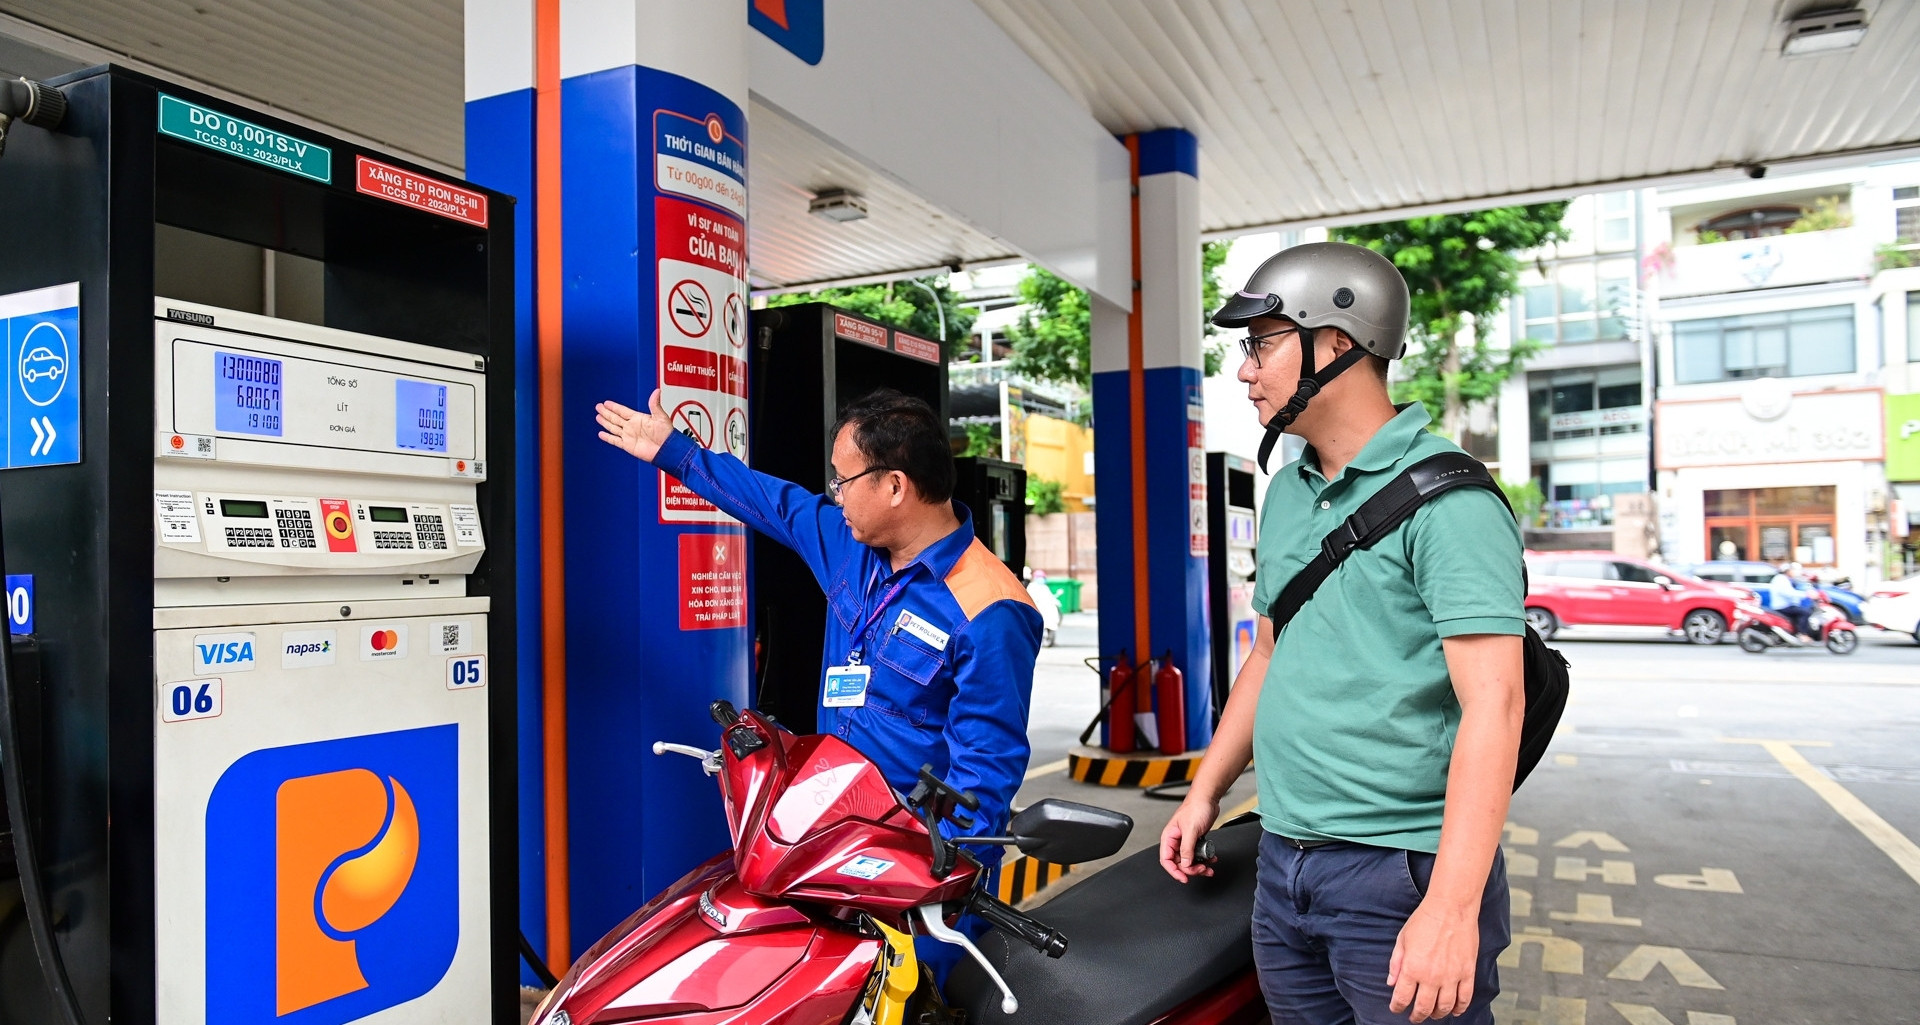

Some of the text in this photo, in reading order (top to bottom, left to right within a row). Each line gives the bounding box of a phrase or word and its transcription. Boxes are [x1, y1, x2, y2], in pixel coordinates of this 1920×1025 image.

[190, 108, 307, 157] DO 0,001S-V
[194, 130, 227, 147] TCCS
[230, 141, 243, 152] 03
[253, 149, 302, 171] 2023/PLX
[664, 134, 692, 154] THỜI
[694, 143, 715, 162] GIAN
[717, 152, 731, 170] BÁN
[368, 166, 478, 209] XĂNG E10 RON 95-III
[667, 166, 683, 181] Từ
[685, 171, 713, 190] 00g00
[716, 182, 729, 197] đến
[381, 184, 407, 199] TCCS
[409, 193, 420, 203] 07
[428, 199, 467, 217] 2023/PLX
[688, 213, 739, 242] VÌ SỰ AN TOÀN
[689, 234, 739, 271] CỦA BẠN
[169, 309, 213, 324] TATSUNO
[223, 355, 279, 385] 1300080
[667, 361, 716, 377] CẤM HÚT THUỐC
[327, 376, 358, 388] TỔNG SỐ
[337, 403, 348, 412] LÍT
[438, 387, 444, 407] 0
[249, 413, 279, 430] 19100
[420, 432, 444, 446] 19830
[666, 495, 681, 506] ĐIỆN
[682, 497, 698, 507] THOẠI
[692, 571, 718, 580] NGHIÊM
[719, 571, 731, 579] CẤM
[688, 599, 704, 608] HÓA
[705, 599, 718, 607] ĐƠN
[695, 612, 711, 621] TRÁI
[712, 611, 728, 620] PHÁP
[910, 620, 945, 645] PETROLIMEX
[196, 641, 254, 665] VISA
[286, 643, 321, 656] napas
[453, 659, 480, 685] 05
[172, 683, 213, 716] 06
